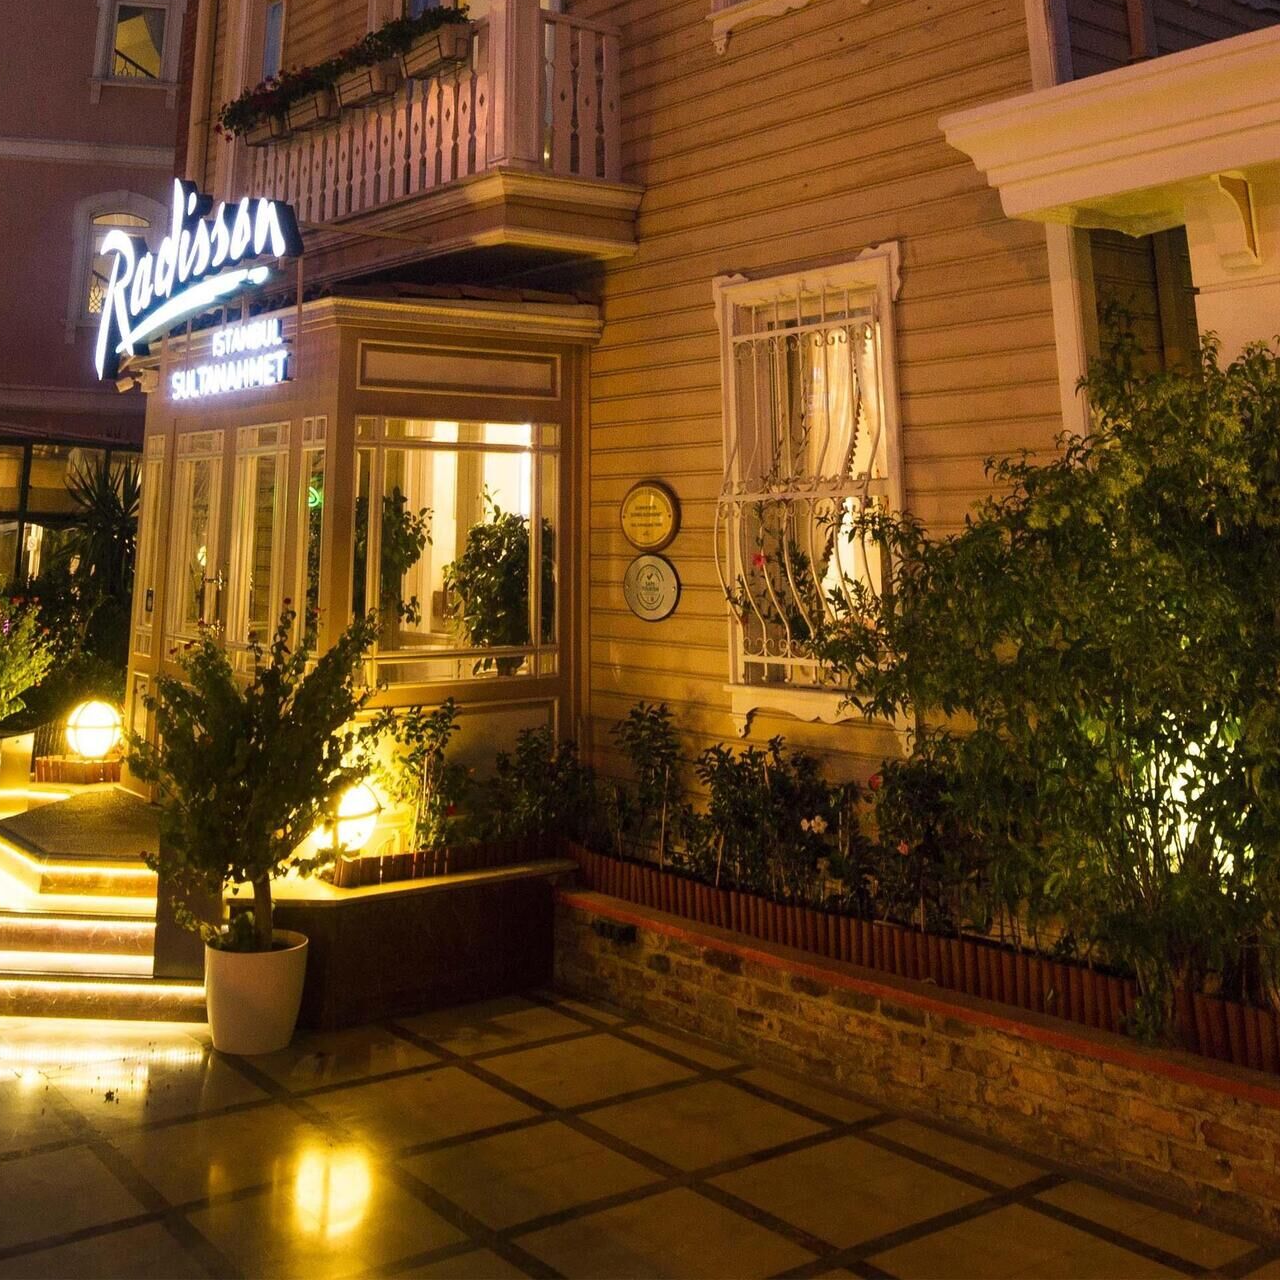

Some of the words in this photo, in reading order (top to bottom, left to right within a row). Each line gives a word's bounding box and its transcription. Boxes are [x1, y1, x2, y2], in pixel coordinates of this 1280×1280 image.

[95, 178, 286, 381] Radisson
[212, 318, 282, 357] ISTANBUL
[171, 349, 288, 401] SULTANAHMET
